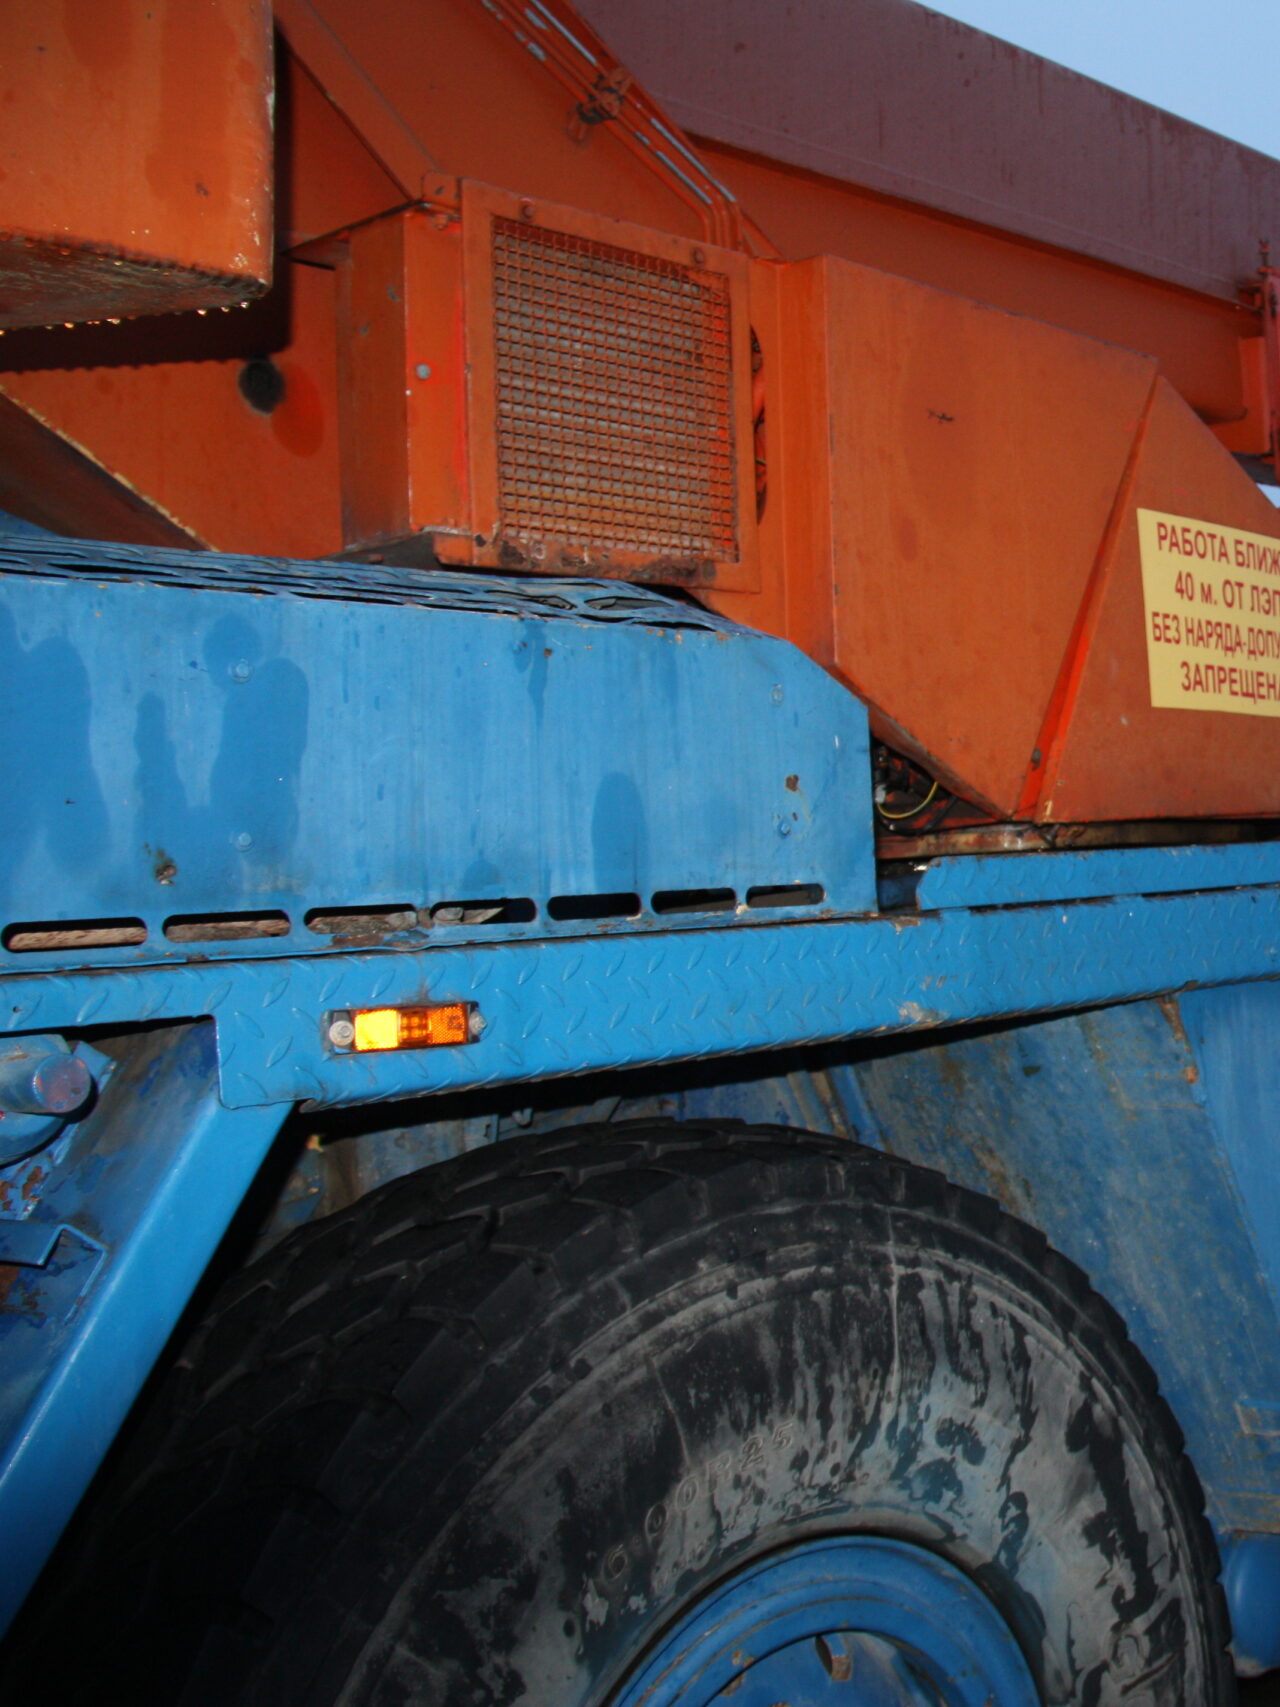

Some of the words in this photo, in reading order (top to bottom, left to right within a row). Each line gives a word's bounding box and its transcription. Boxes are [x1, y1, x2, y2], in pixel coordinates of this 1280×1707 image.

[1157, 521, 1229, 565] РАБОТА
[1175, 570, 1195, 602] 40
[1201, 582, 1218, 605] м.
[1222, 579, 1244, 610] ОТ
[1151, 611, 1181, 645] БЕЗ
